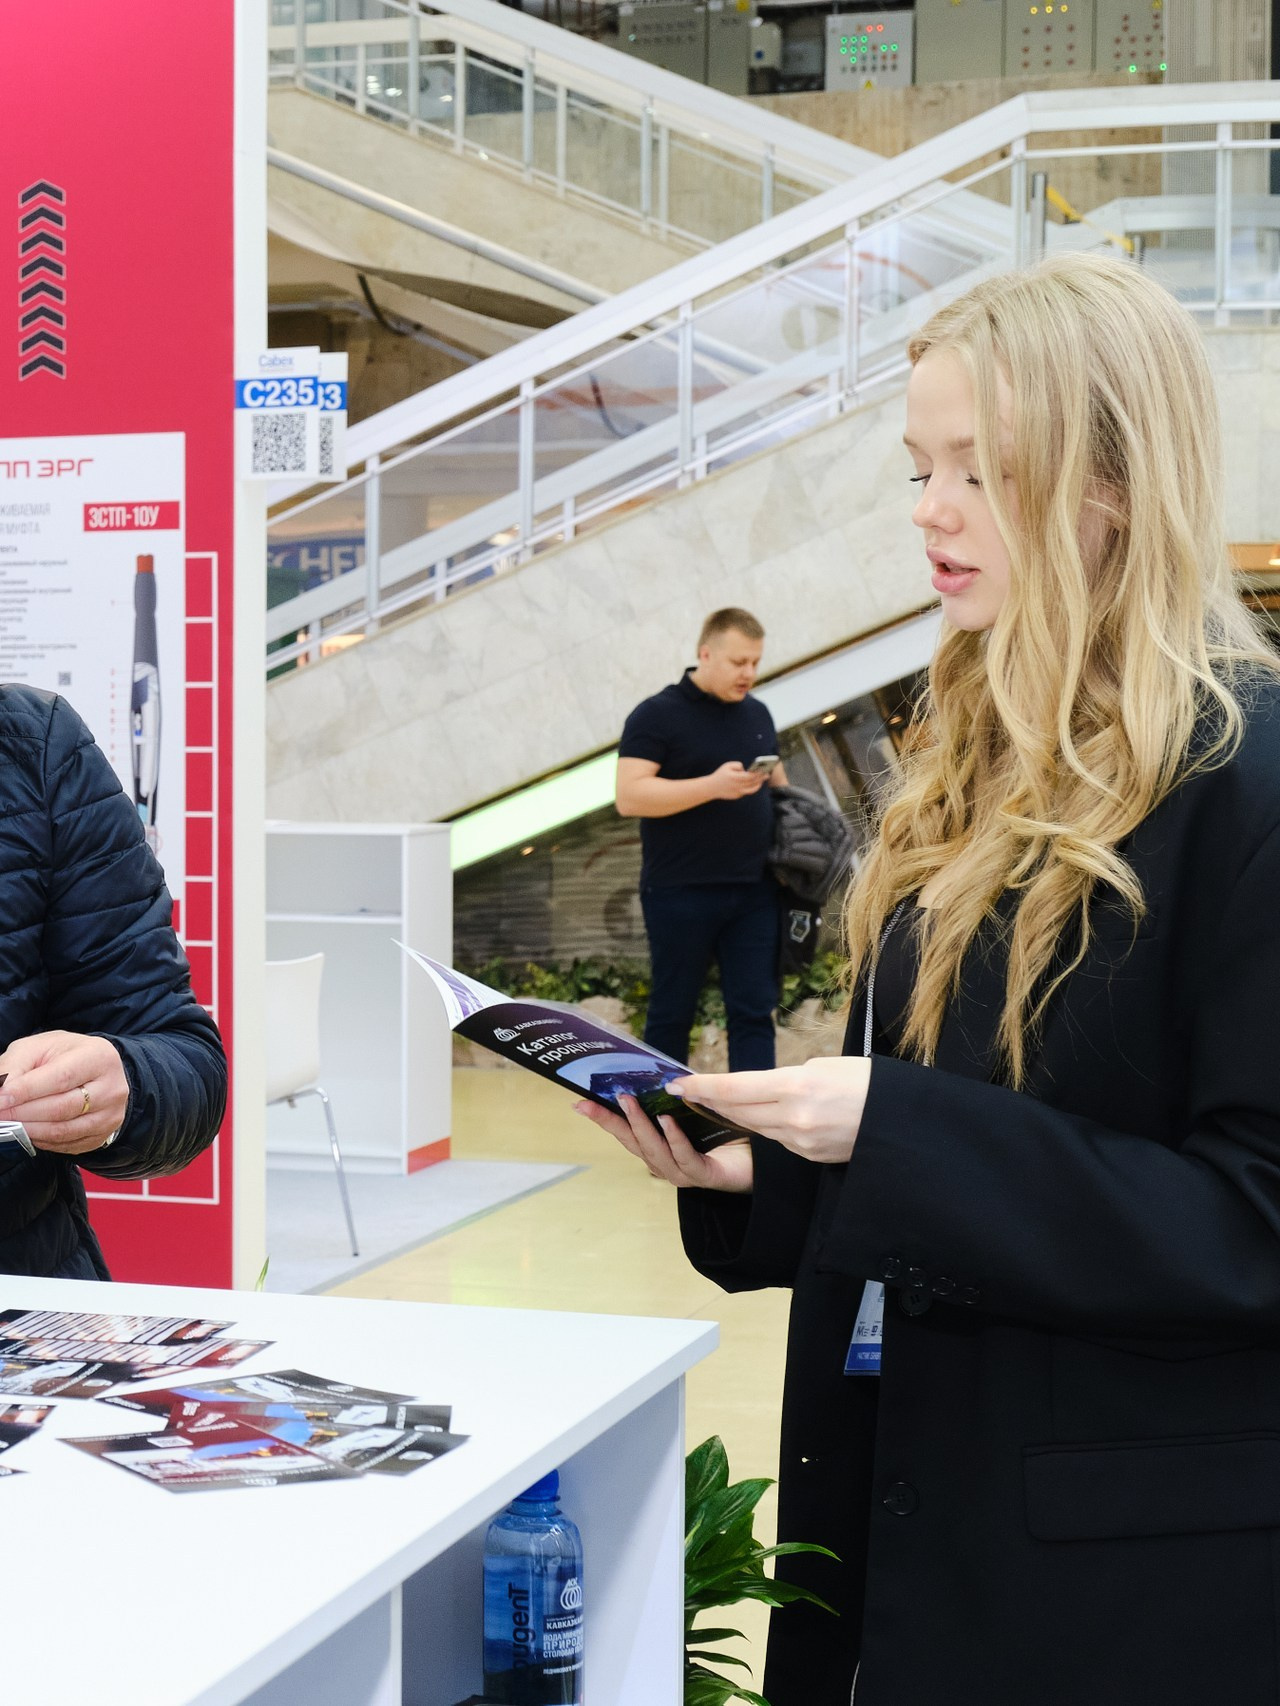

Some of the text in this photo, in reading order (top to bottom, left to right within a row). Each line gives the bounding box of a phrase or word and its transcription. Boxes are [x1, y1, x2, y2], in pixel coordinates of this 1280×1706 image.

[243, 379, 315, 407] C235
[37, 458, 94, 478] ЭРГ
[516, 1032, 578, 1056] Каталог
